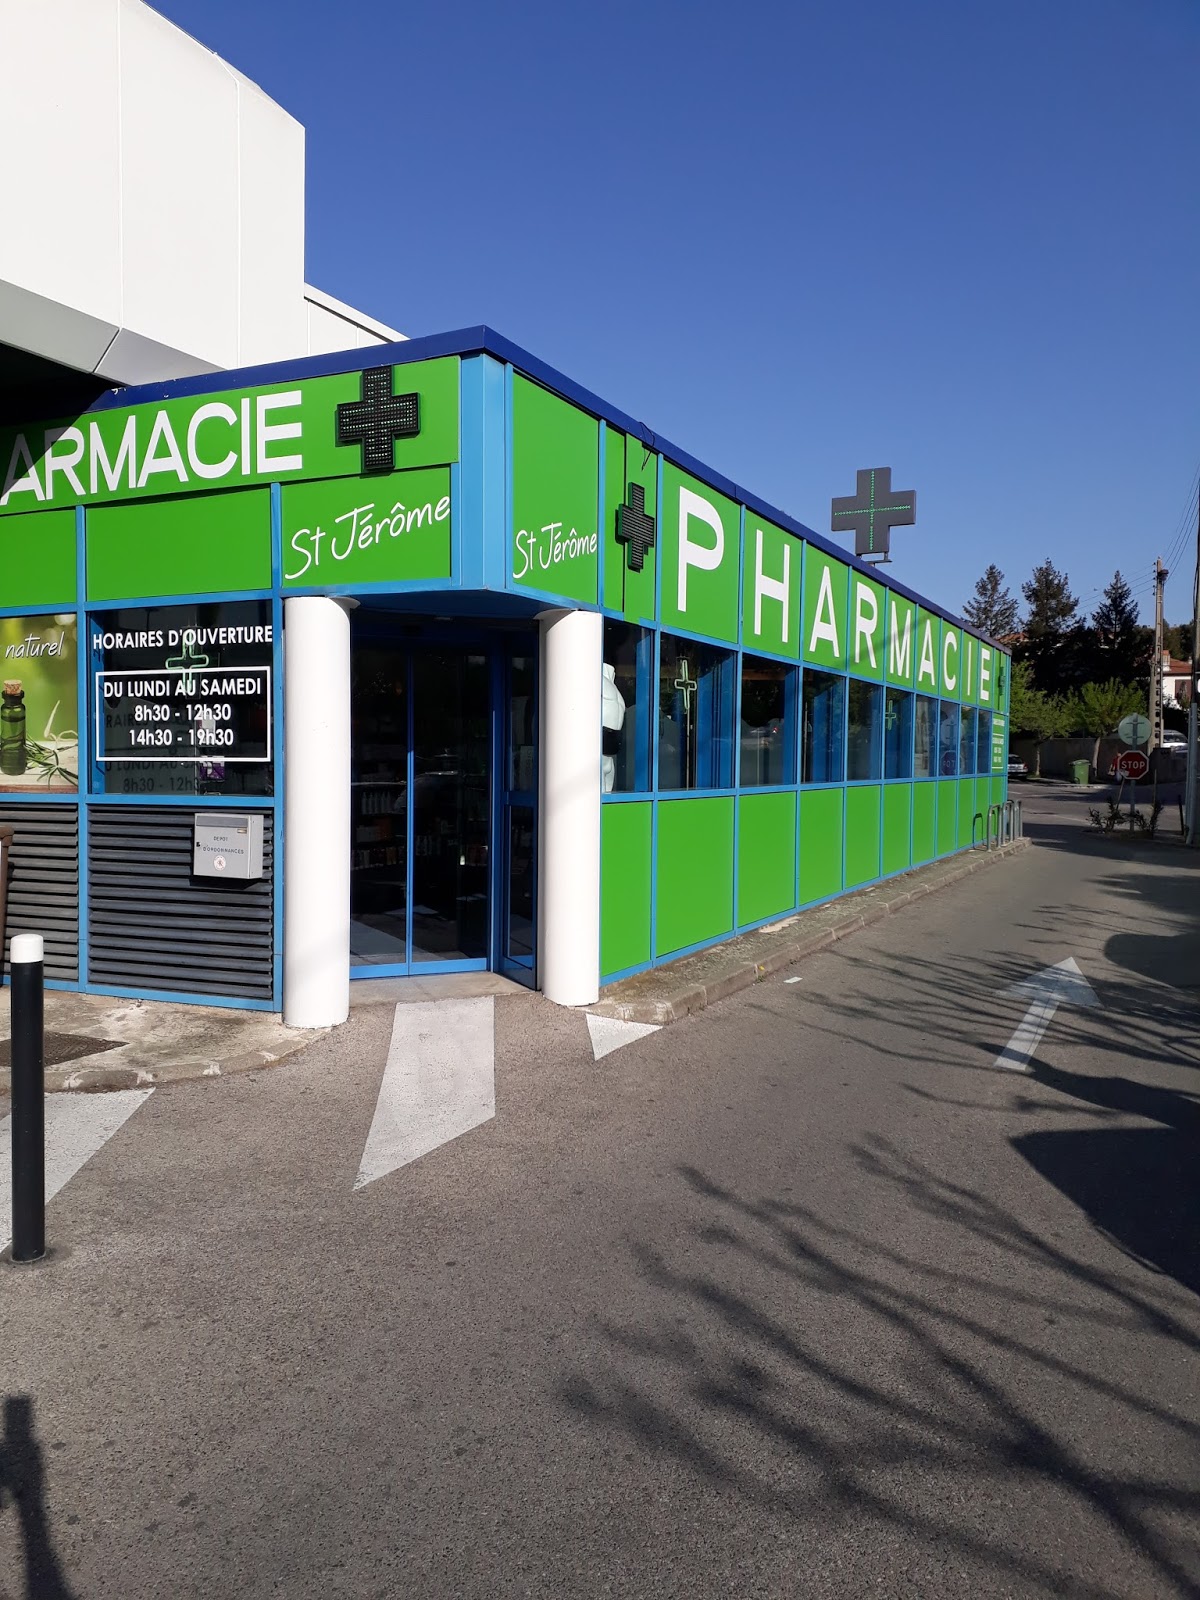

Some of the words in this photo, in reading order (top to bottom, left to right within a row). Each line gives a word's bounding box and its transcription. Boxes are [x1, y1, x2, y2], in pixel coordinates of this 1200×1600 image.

[0, 389, 303, 506] ARMACIE
[284, 526, 326, 580] St
[330, 495, 451, 561] Jérôme
[512, 529, 537, 579] St
[539, 521, 598, 568] Jérôme
[677, 485, 992, 702] PHARMACIE
[5, 631, 65, 659] naturel
[93, 630, 164, 650] HORAIRES
[168, 625, 273, 647] D'OUVERTURE
[103, 682, 123, 698] DU
[127, 680, 170, 697] LUNDI
[174, 679, 196, 696] AU
[201, 678, 261, 696] SAMEDI
[134, 704, 171, 721] 8h30
[185, 703, 232, 721] 12h30
[129, 729, 173, 746] 14h30
[188, 728, 234, 746] 19h30
[1121, 761, 1145, 769] STOP
